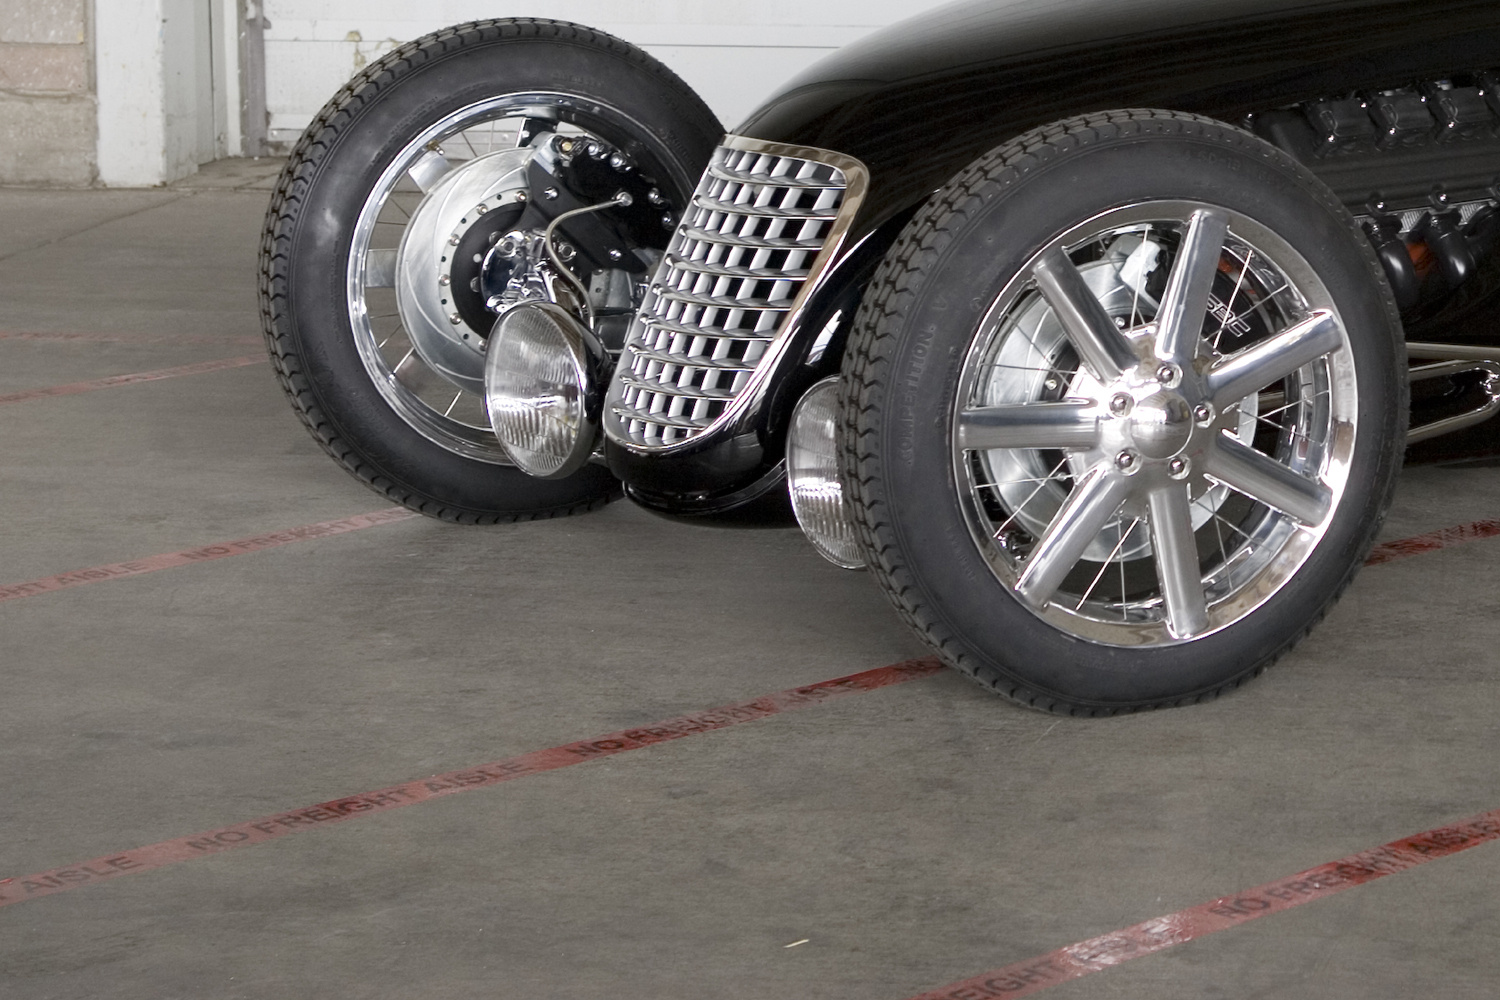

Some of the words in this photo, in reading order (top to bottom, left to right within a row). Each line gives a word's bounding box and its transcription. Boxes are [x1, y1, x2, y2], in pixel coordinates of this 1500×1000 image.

[21, 856, 145, 893] AISLE
[186, 831, 249, 850] NO
[251, 788, 416, 834] FREIGHT
[424, 762, 533, 794] AISLE
